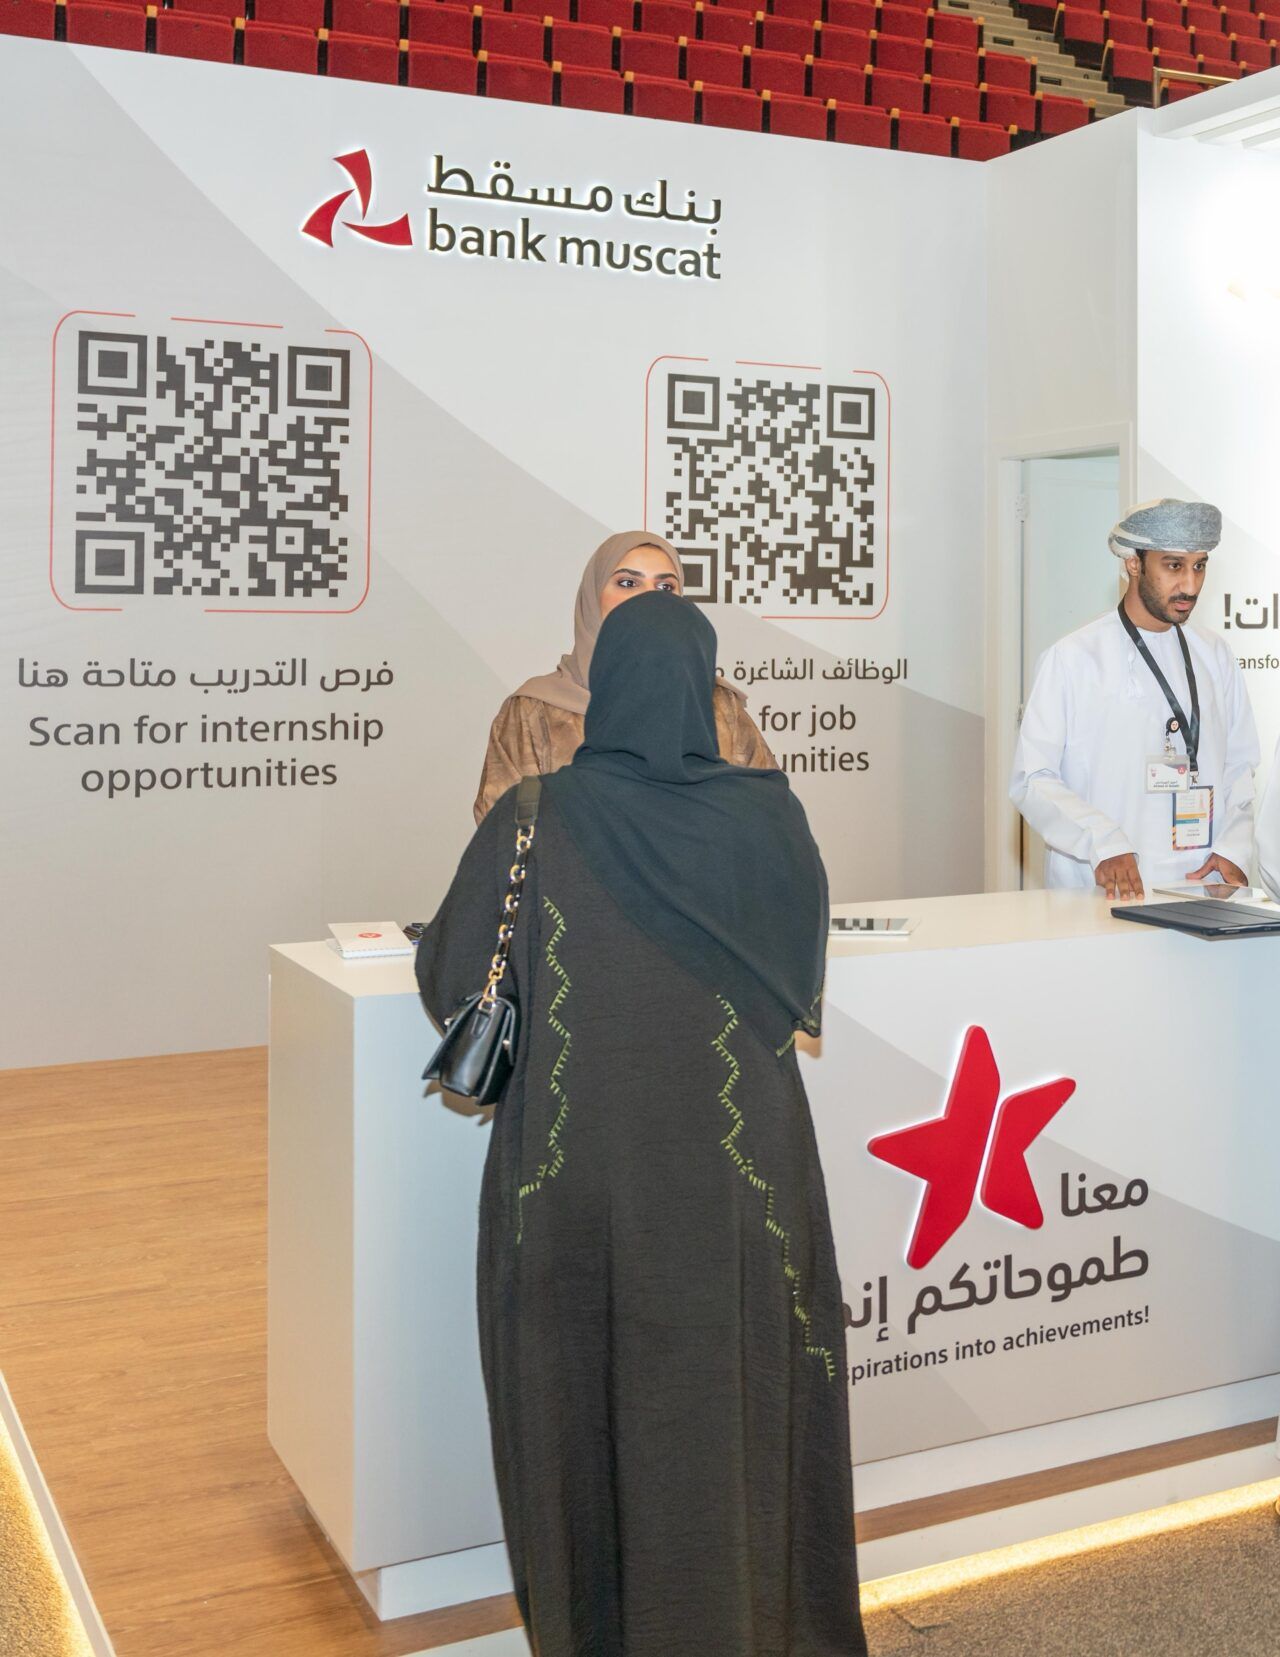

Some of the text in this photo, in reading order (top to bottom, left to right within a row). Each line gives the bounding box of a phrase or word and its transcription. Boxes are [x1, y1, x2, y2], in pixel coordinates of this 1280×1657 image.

[428, 155, 721, 235] بنك مسقط
[429, 208, 720, 279] bank muscat
[19, 658, 393, 694] فرص التدريب متاحة هنا
[734, 658, 813, 685] الشاغرة
[822, 659, 907, 684] الوظائف
[30, 713, 383, 747] Scan for internship
[758, 704, 856, 737] for job
[82, 758, 337, 798] opportunities
[1061, 1173, 1148, 1217] معنا
[907, 1236, 1148, 1334] طموحاتكم
[956, 1339, 995, 1360] into
[1003, 1305, 1148, 1350] achievements!
